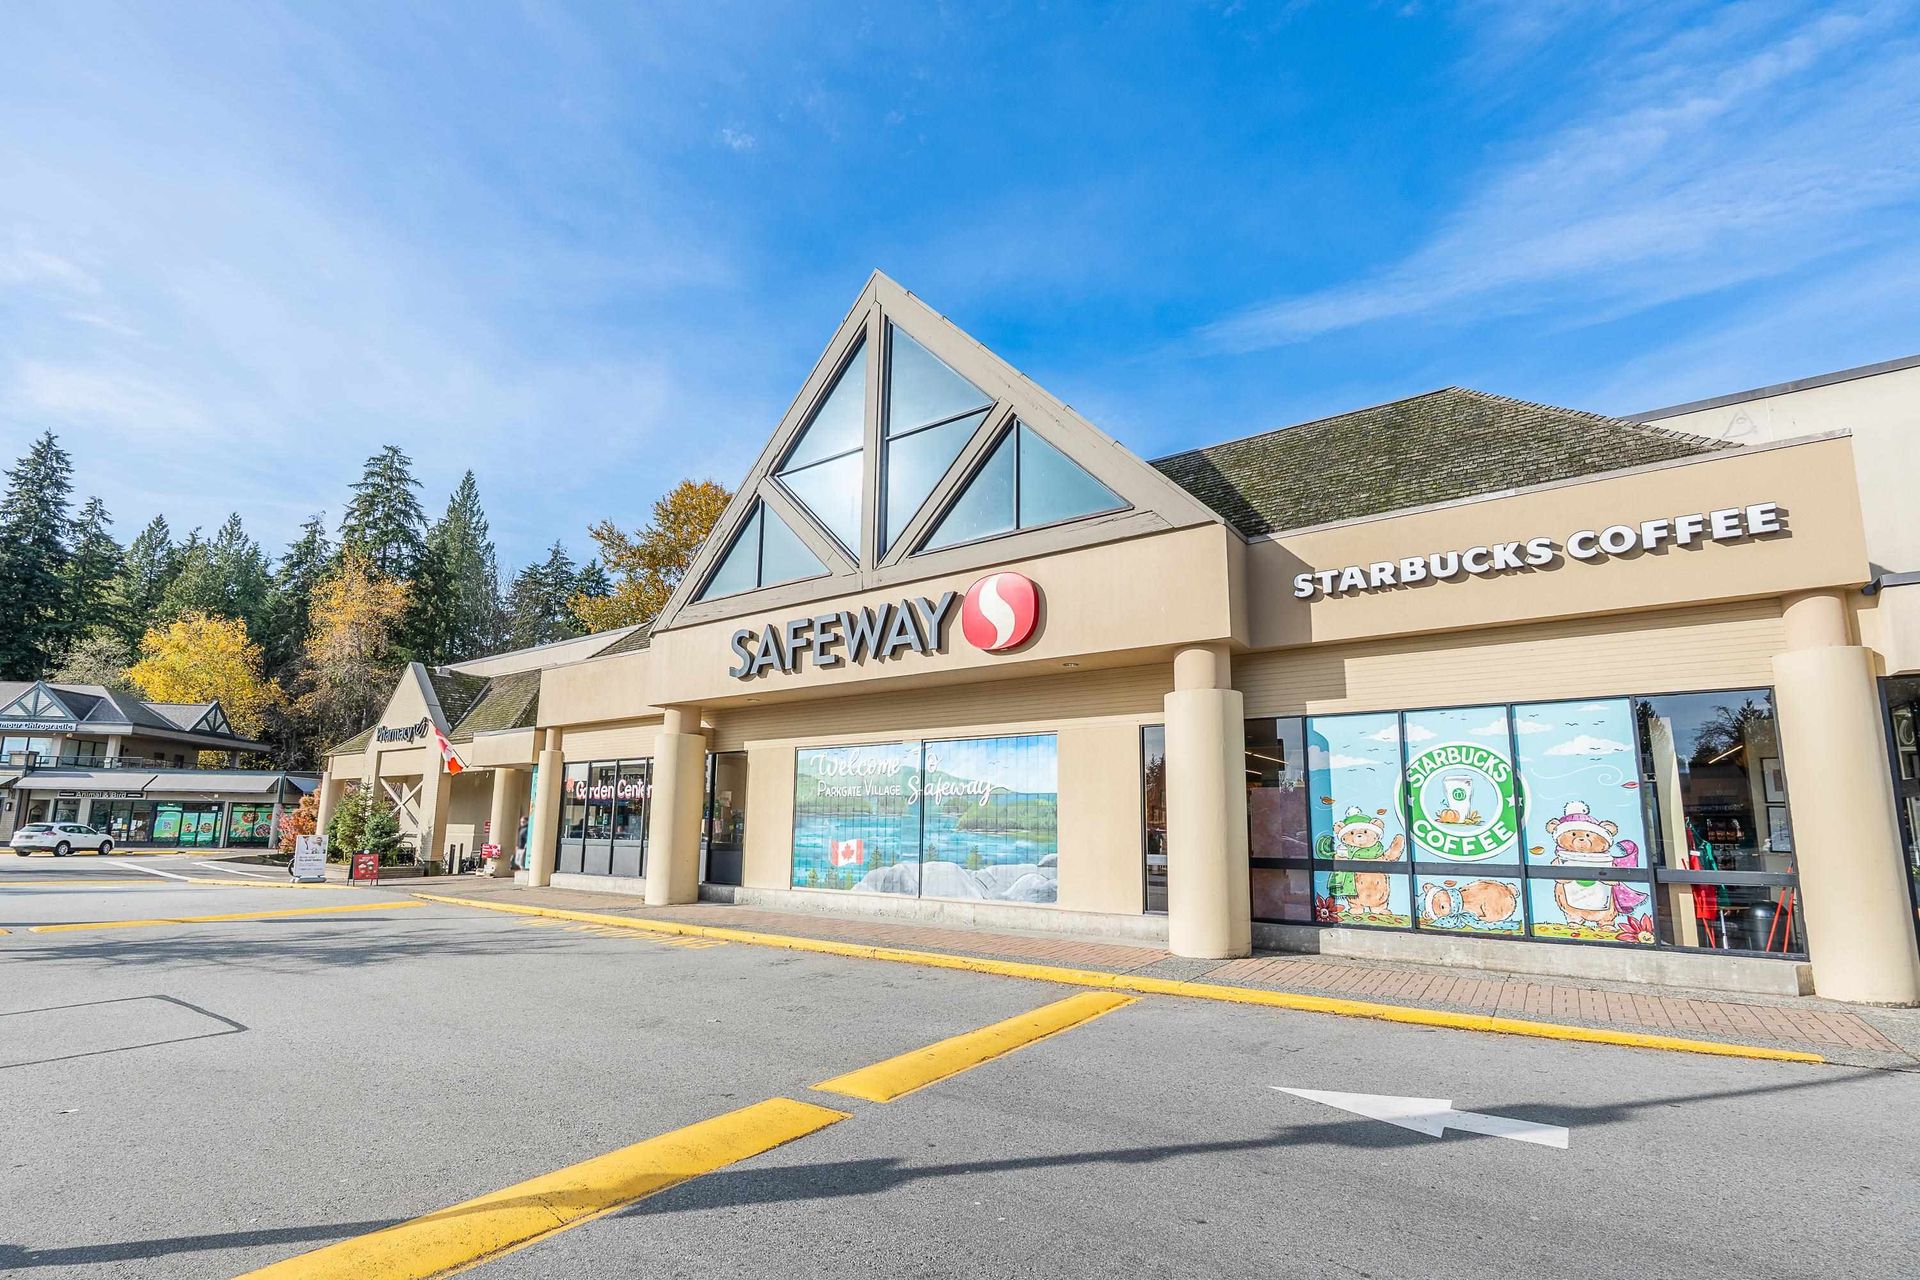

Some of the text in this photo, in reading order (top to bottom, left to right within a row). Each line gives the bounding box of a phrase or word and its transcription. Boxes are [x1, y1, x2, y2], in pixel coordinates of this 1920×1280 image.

[1293, 501, 1780, 598] STARBUCKS COFFEE
[729, 590, 958, 679] SAFEWAY
[377, 725, 414, 744] Pharmacy
[810, 748, 900, 777] Welcome
[1406, 746, 1511, 788] STARBUCKS
[76, 791, 102, 799] Animal
[112, 791, 127, 799] Bird
[576, 779, 615, 800] Garden
[907, 775, 996, 807] Safeway
[1412, 819, 1513, 856] COFFEE
